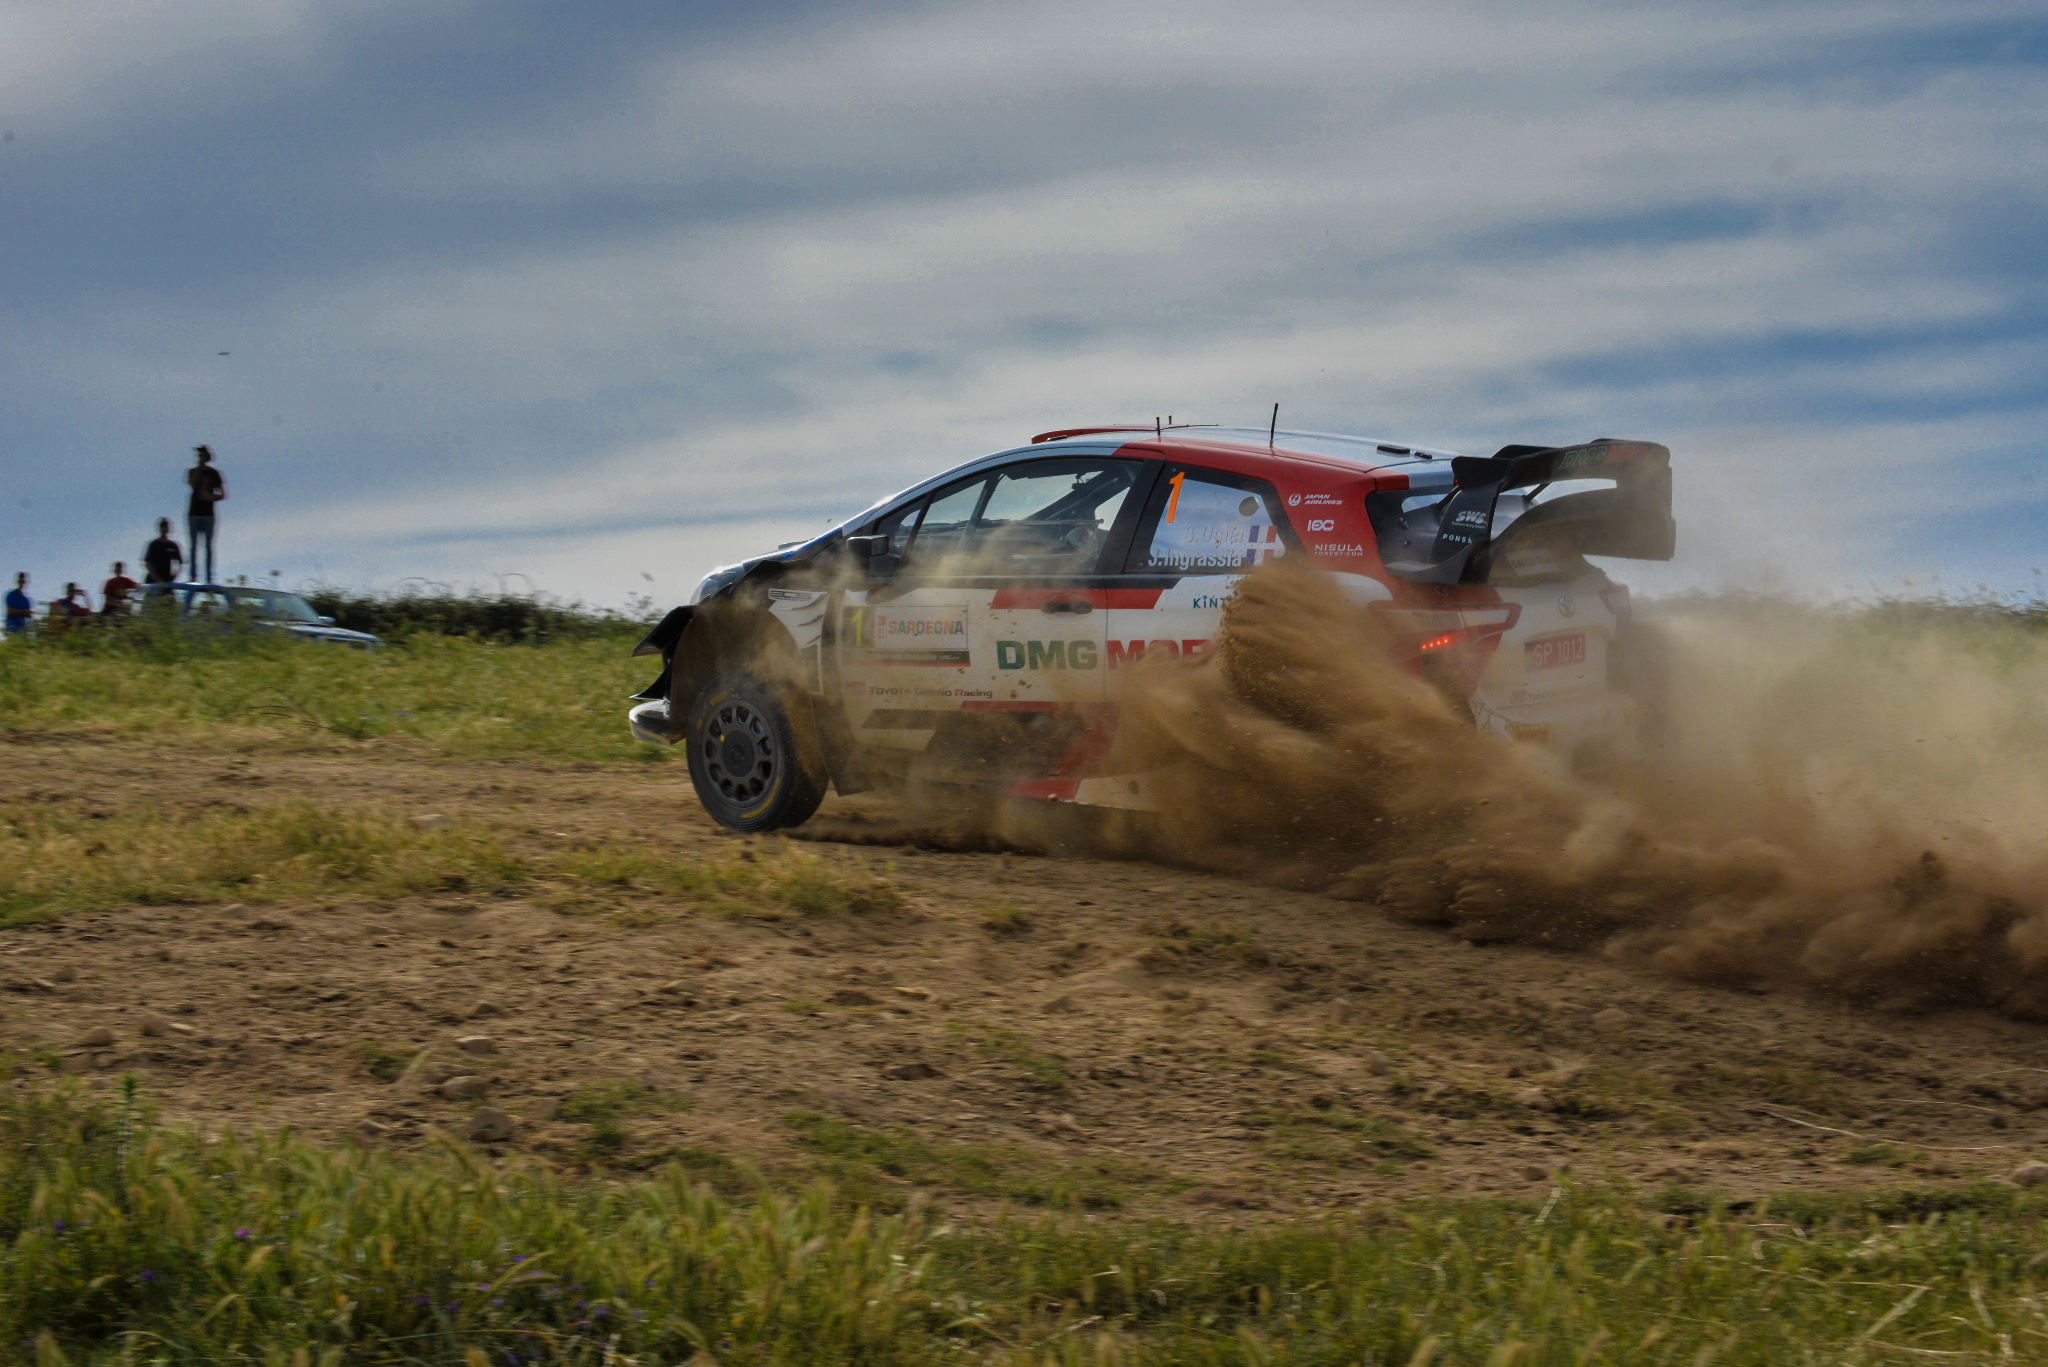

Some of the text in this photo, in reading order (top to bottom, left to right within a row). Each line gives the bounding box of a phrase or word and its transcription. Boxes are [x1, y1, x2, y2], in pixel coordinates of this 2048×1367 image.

[1165, 471, 1185, 524] 1
[1314, 543, 1363, 552] NISULA
[851, 608, 864, 647] 1
[888, 620, 965, 635] SARDEGNA
[996, 640, 1099, 670] DMG
[1535, 637, 1584, 666] SP 1012
[955, 689, 993, 699] Racing
